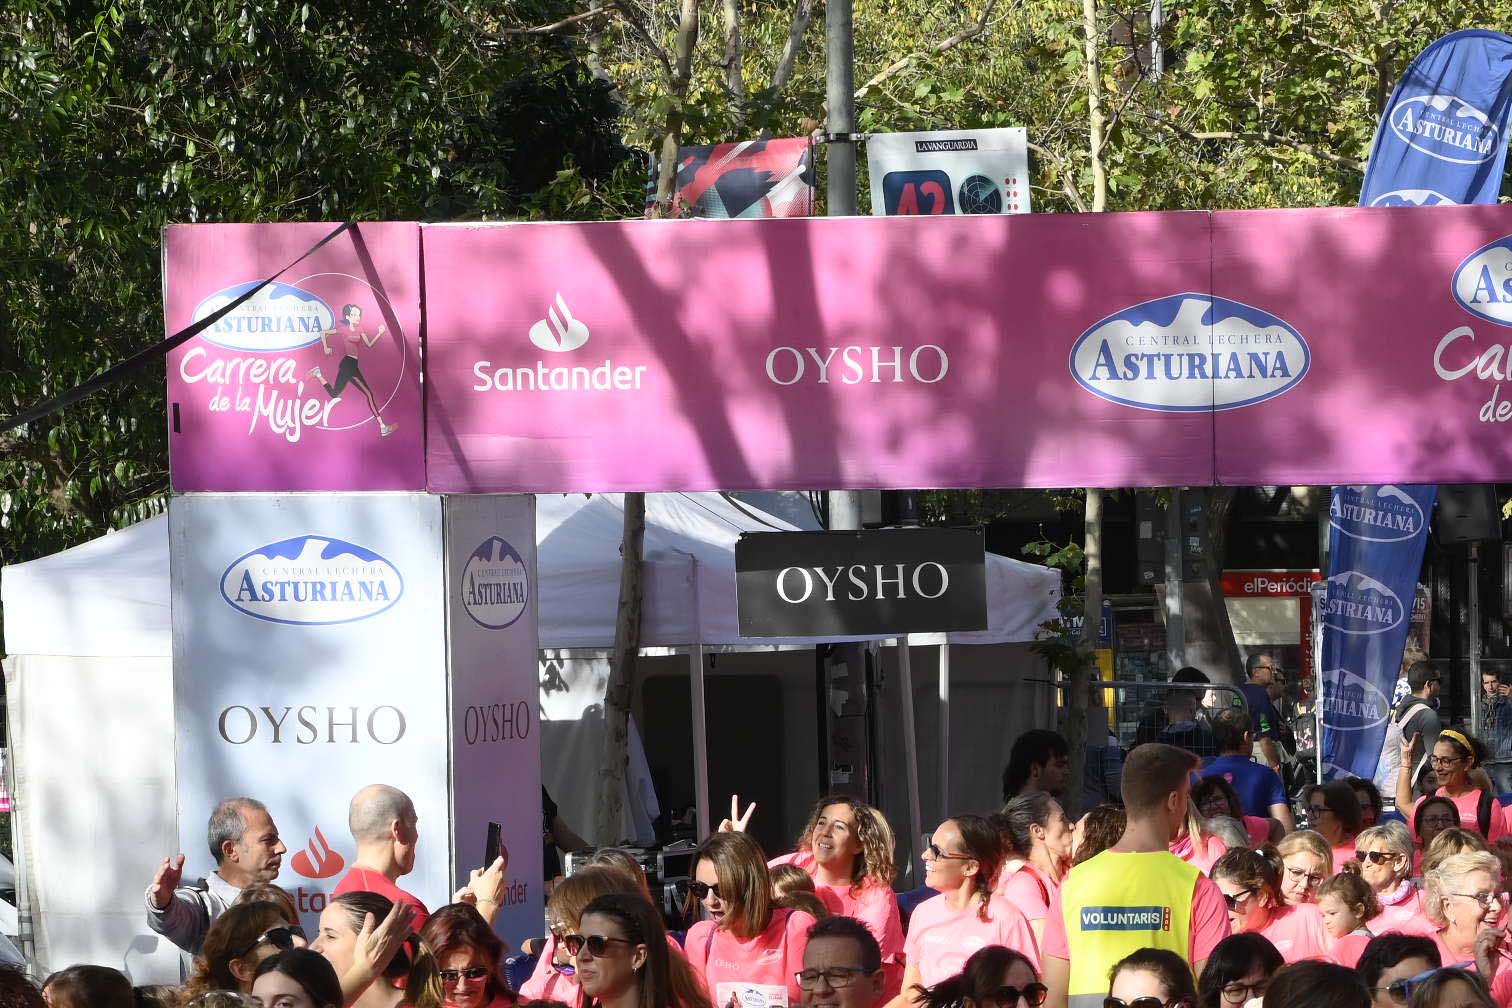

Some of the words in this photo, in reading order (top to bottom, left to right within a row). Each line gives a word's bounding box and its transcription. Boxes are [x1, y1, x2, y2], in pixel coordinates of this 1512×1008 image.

[1397, 107, 1493, 154] ASTURIANA
[1125, 335, 1200, 346] CENTRAL
[1208, 332, 1284, 345] LECHERA
[180, 346, 297, 385] Carrera
[473, 359, 647, 391] Santander
[765, 344, 949, 386] OYSHO
[1088, 338, 1292, 381] ASTURIANA
[208, 386, 231, 412] de
[234, 384, 252, 412] la
[247, 381, 342, 443] Mujer
[1330, 493, 1415, 533] ASTURIANA
[235, 568, 390, 603] ASTURIANA
[262, 566, 319, 578] CENTRAL
[324, 566, 385, 577] LECHERA
[467, 570, 525, 607] ASTURIANA
[776, 560, 950, 604] OYSHO
[218, 704, 408, 746] OYSHO
[464, 700, 530, 746] OYSHO
[1082, 911, 1160, 926] VOLUNTARIS
